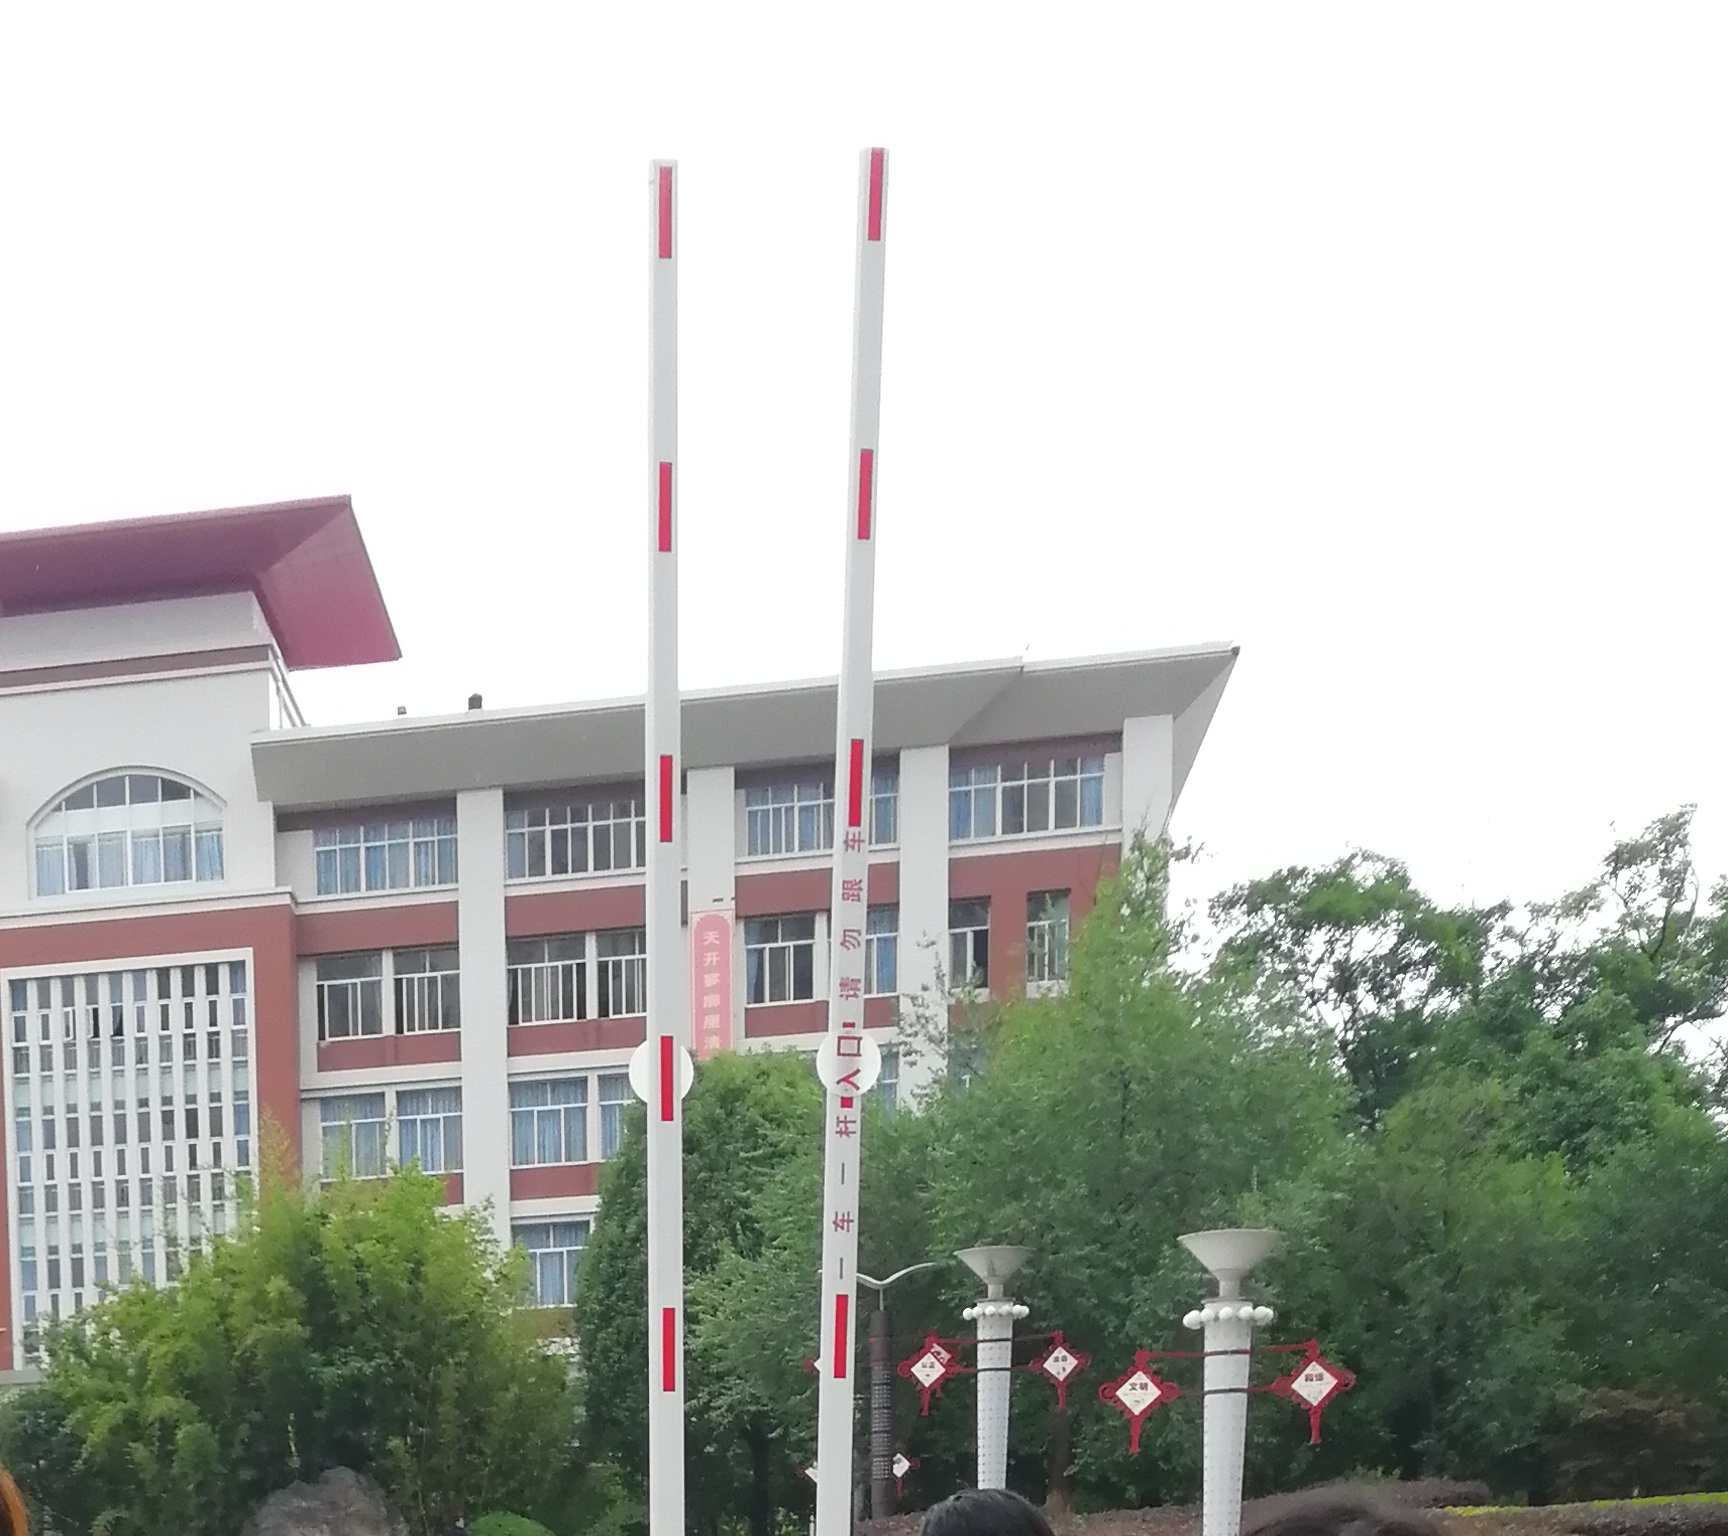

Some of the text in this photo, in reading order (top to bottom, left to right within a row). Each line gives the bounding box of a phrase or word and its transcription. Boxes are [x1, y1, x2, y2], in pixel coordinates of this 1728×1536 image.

[839, 830, 865, 1001] 请勿跟车
[836, 1036, 862, 1090] 入口
[832, 1114, 857, 1280] 一车一杆
[1128, 1382, 1149, 1392] 文明
